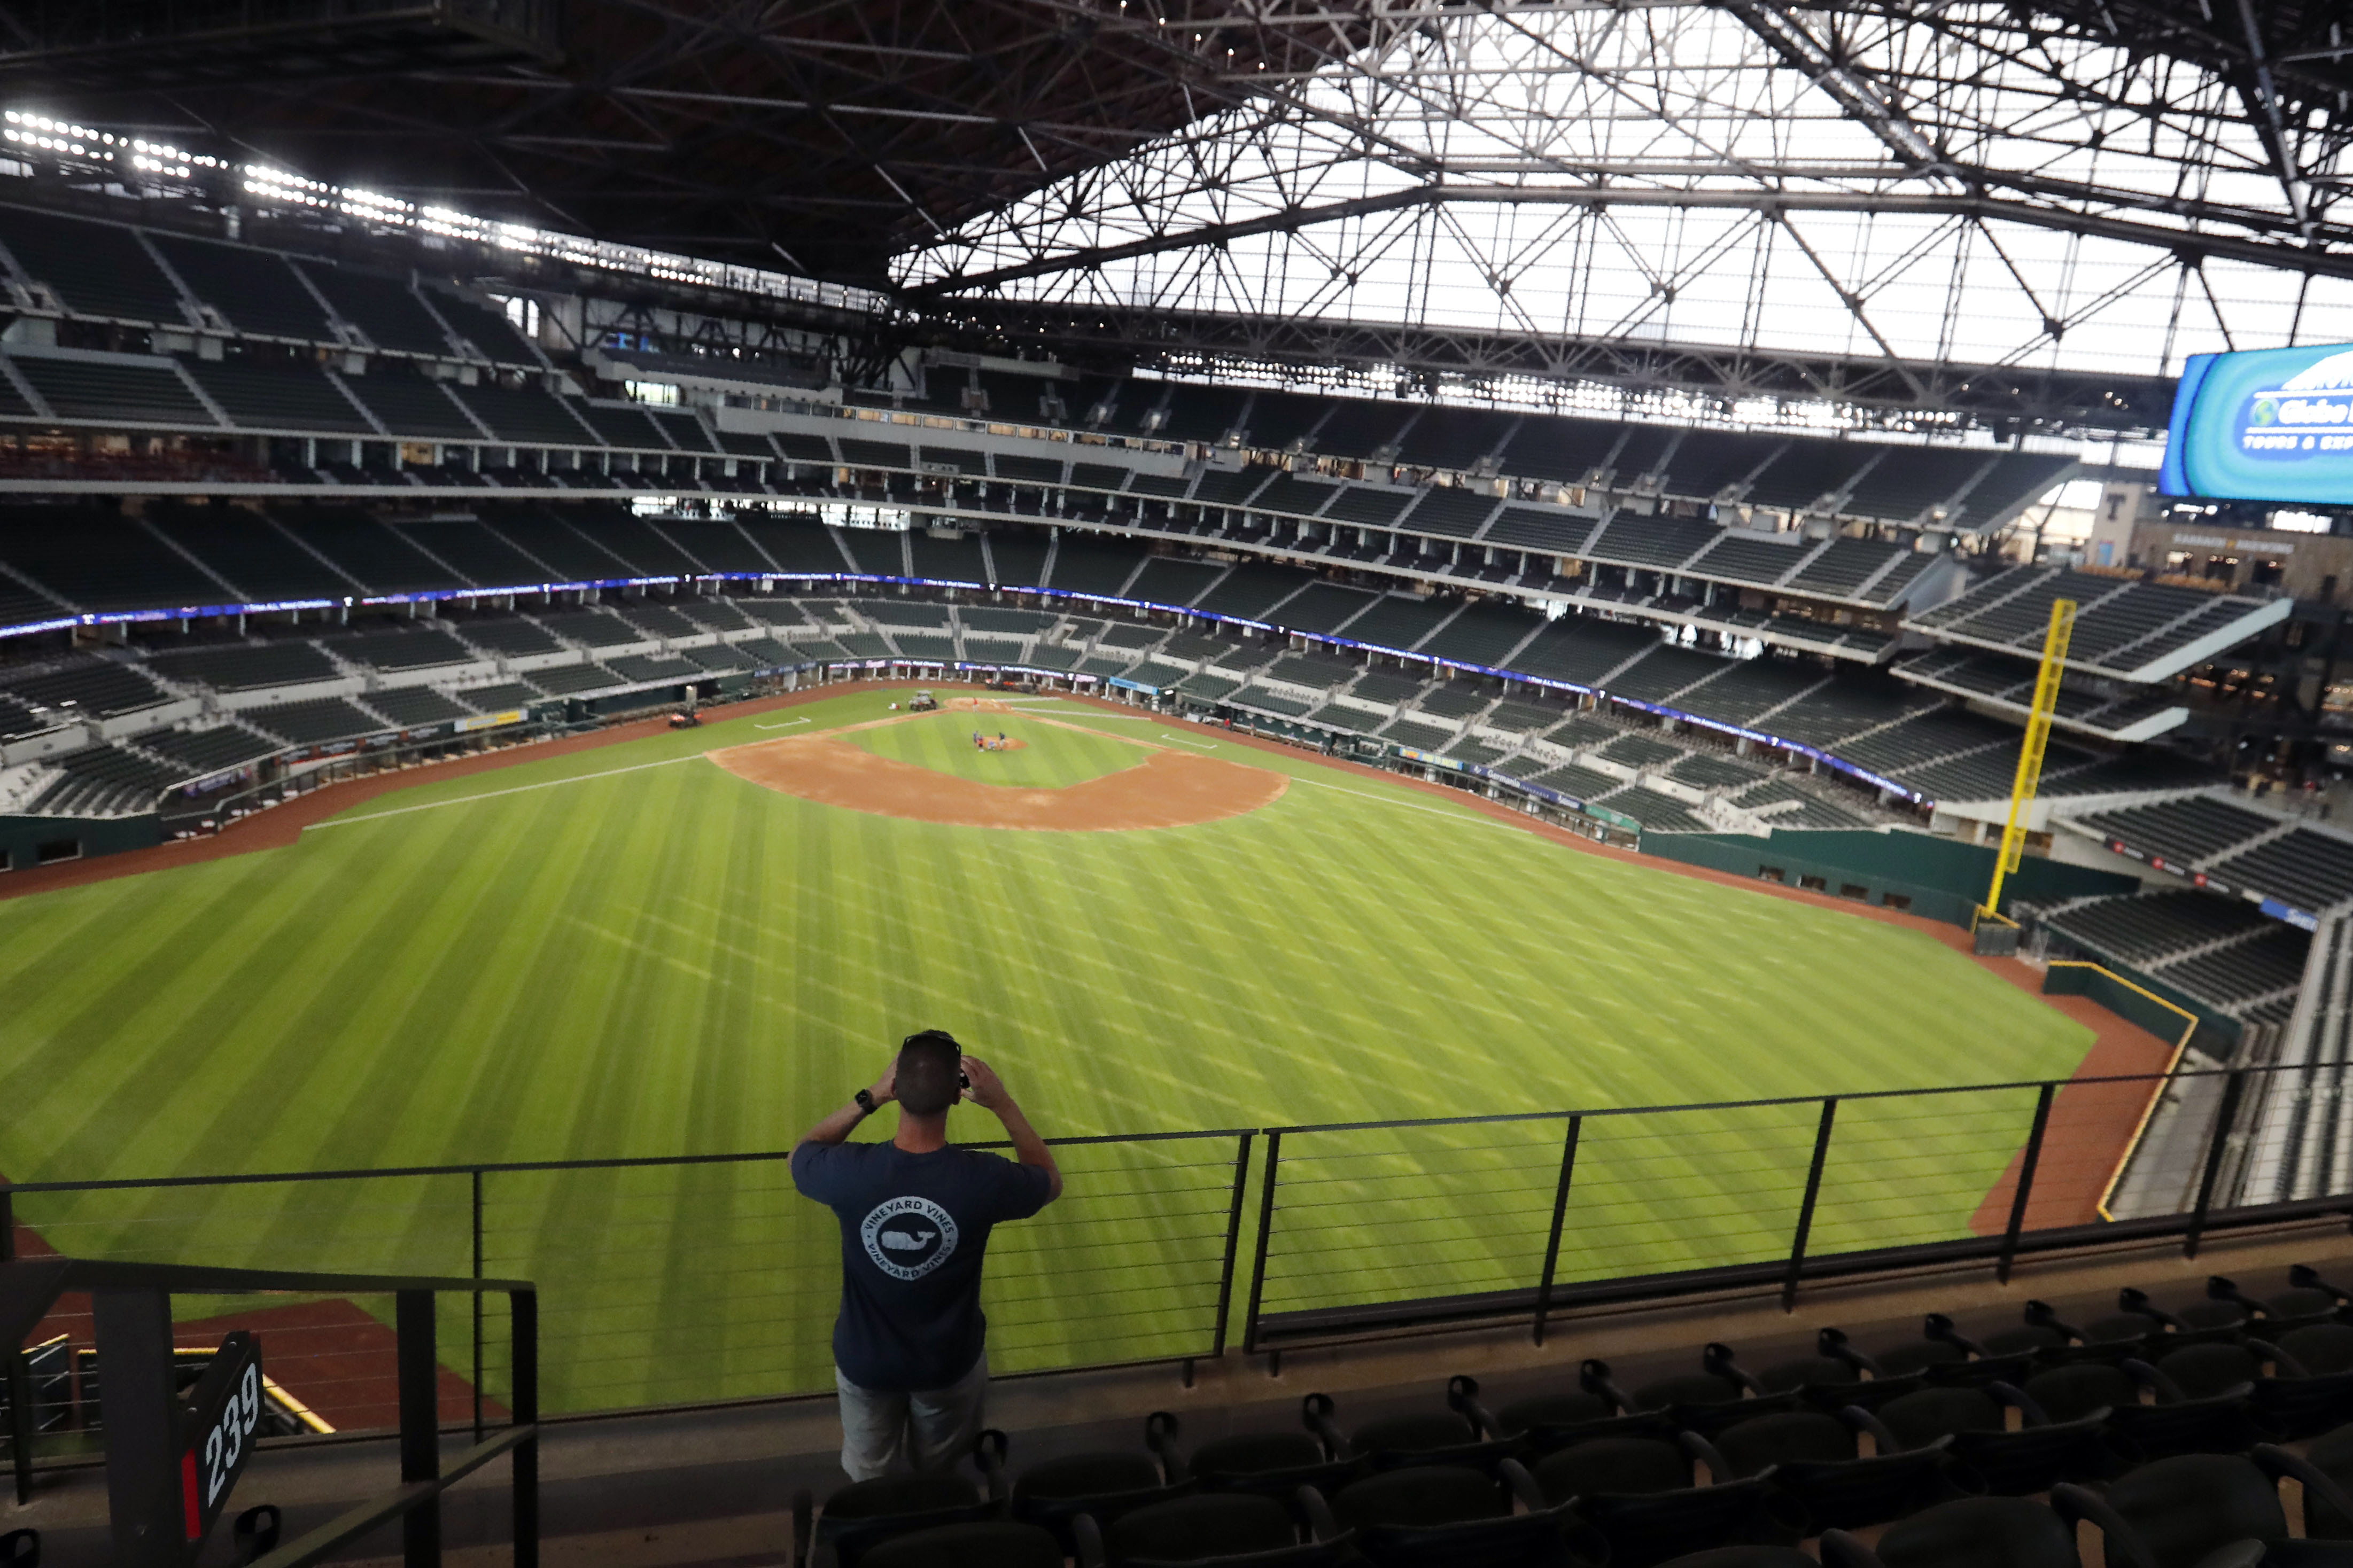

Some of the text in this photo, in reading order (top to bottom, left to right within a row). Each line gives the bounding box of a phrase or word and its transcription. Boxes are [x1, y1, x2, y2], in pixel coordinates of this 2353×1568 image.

[2278, 399, 2348, 424] Globe
[2243, 435, 2297, 449] TOURS
[1487, 769, 1520, 788] Germania
[865, 1200, 954, 1233] VINEYARD VINES
[868, 1243, 951, 1278] VINEYARD VINES
[205, 1362, 258, 1508] 239
